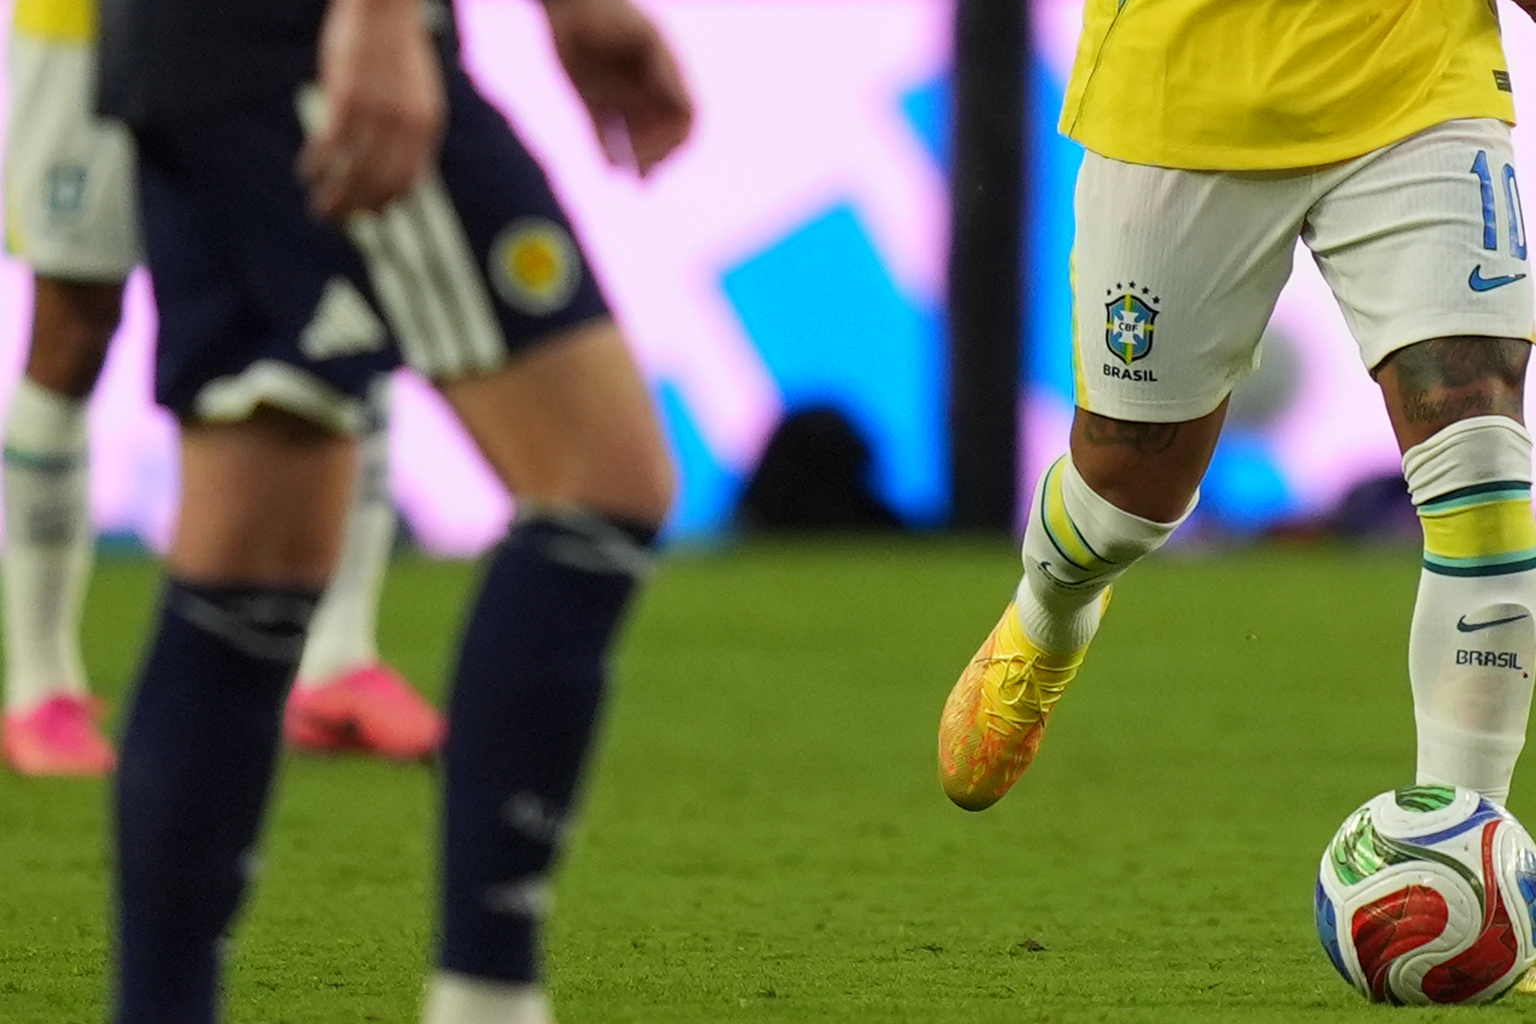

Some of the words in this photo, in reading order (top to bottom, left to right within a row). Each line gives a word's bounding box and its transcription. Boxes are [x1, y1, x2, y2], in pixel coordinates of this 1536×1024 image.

[1469, 150, 1528, 261] 10
[1118, 322, 1138, 332] CBF
[1103, 363, 1158, 382] BRASIL
[1456, 649, 1523, 670] BRASIL
